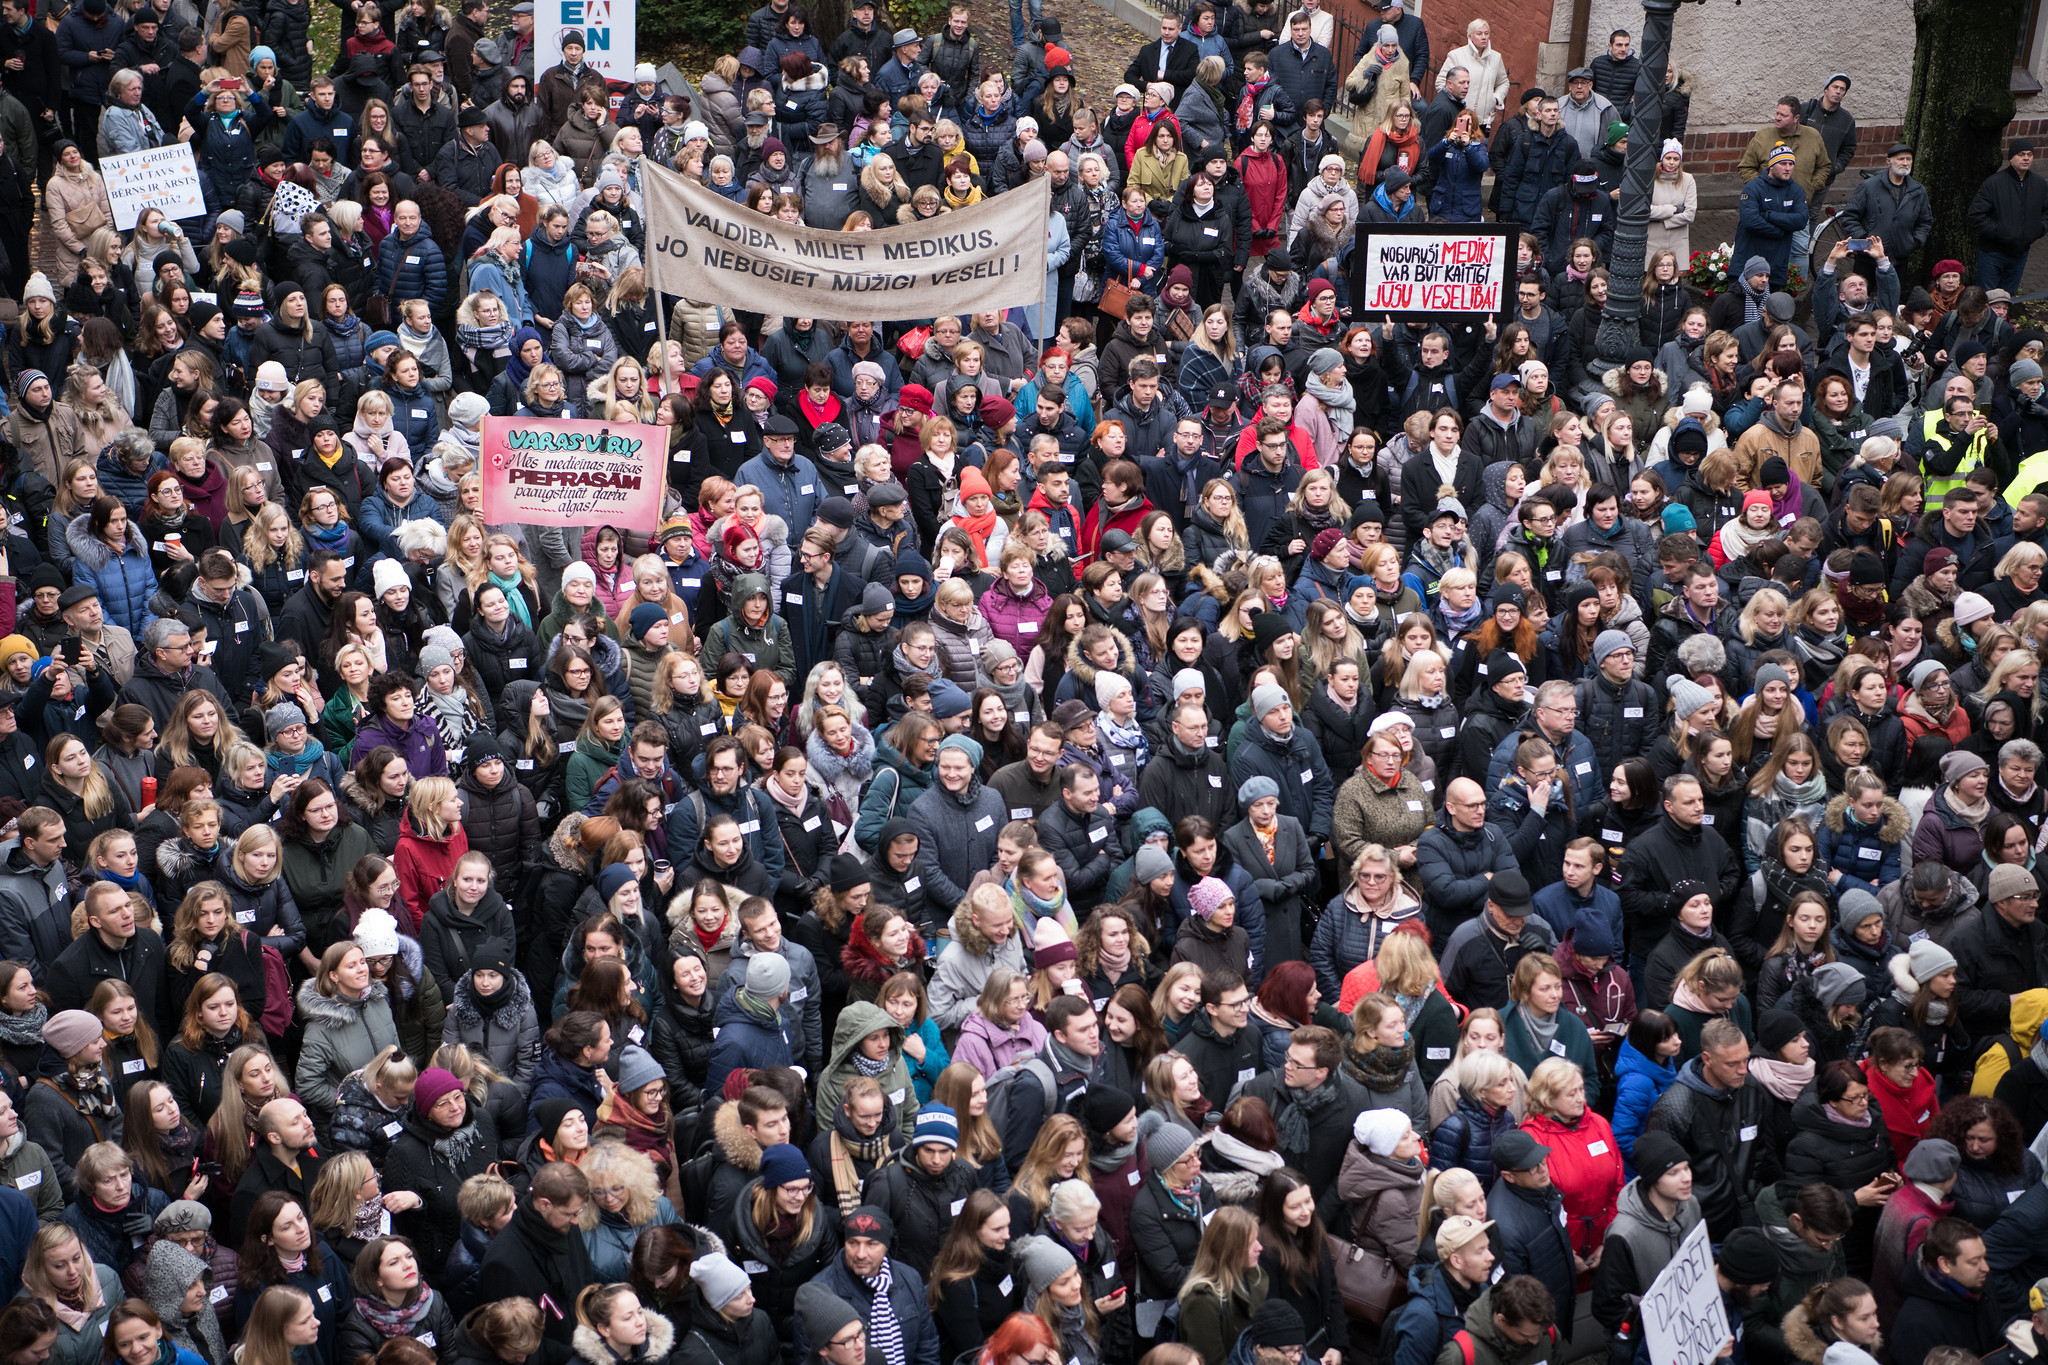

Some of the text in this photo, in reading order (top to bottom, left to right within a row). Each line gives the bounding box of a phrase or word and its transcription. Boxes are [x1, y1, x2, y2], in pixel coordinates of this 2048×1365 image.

[101, 161, 121, 171] VAI
[123, 157, 139, 168] TU
[125, 167, 175, 183] LAI TAVS
[111, 175, 197, 199] BĒRNS IR ĀRSTS
[131, 194, 181, 211] LATVIJĀ?
[794, 238, 866, 260] MĪLIET
[883, 229, 999, 260] MEDIĶUS.
[656, 235, 688, 258] JO
[704, 246, 819, 288] NEBŪSIET
[832, 273, 916, 292] MŪŽĪGI
[932, 257, 1004, 286] VESELI
[1383, 264, 1410, 281] VAR
[1414, 264, 1443, 282] BŪT
[1370, 281, 1413, 309] JŪSU
[508, 429, 585, 451] VARAS
[504, 451, 643, 474] Mēs medicīnas māsas
[508, 468, 642, 490] PIEPRASĀM
[514, 486, 628, 503] paaugstināt darba
[558, 500, 598, 518] algas!
[1673, 1302, 1695, 1345] UN
